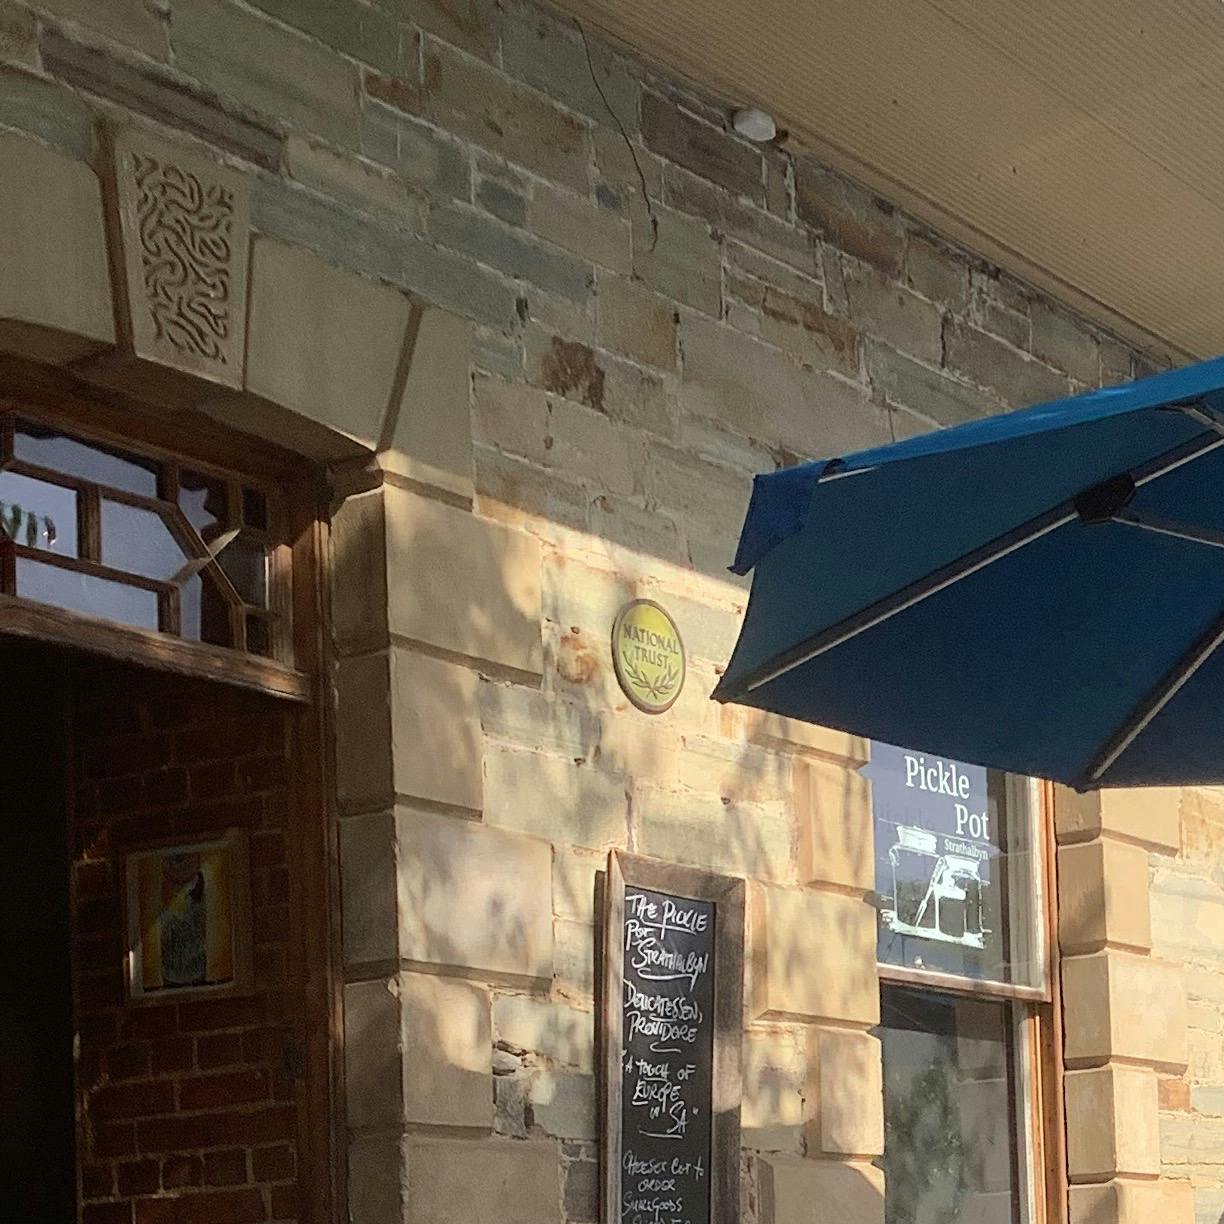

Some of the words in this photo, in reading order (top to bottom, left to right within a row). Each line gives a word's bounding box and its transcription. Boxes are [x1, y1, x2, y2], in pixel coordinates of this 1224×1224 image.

[624, 624, 679, 655] NATIONAL
[634, 646, 669, 668] TRUST
[904, 755, 970, 799] Pickle
[954, 803, 990, 840] Pot
[944, 839, 988, 861] Strathalbyn
[661, 900, 708, 939] PICKLE
[632, 937, 708, 991] STRATHALBYN
[627, 1011, 698, 1042] PROVIDORE
[633, 1079, 681, 1113] EUROPE
